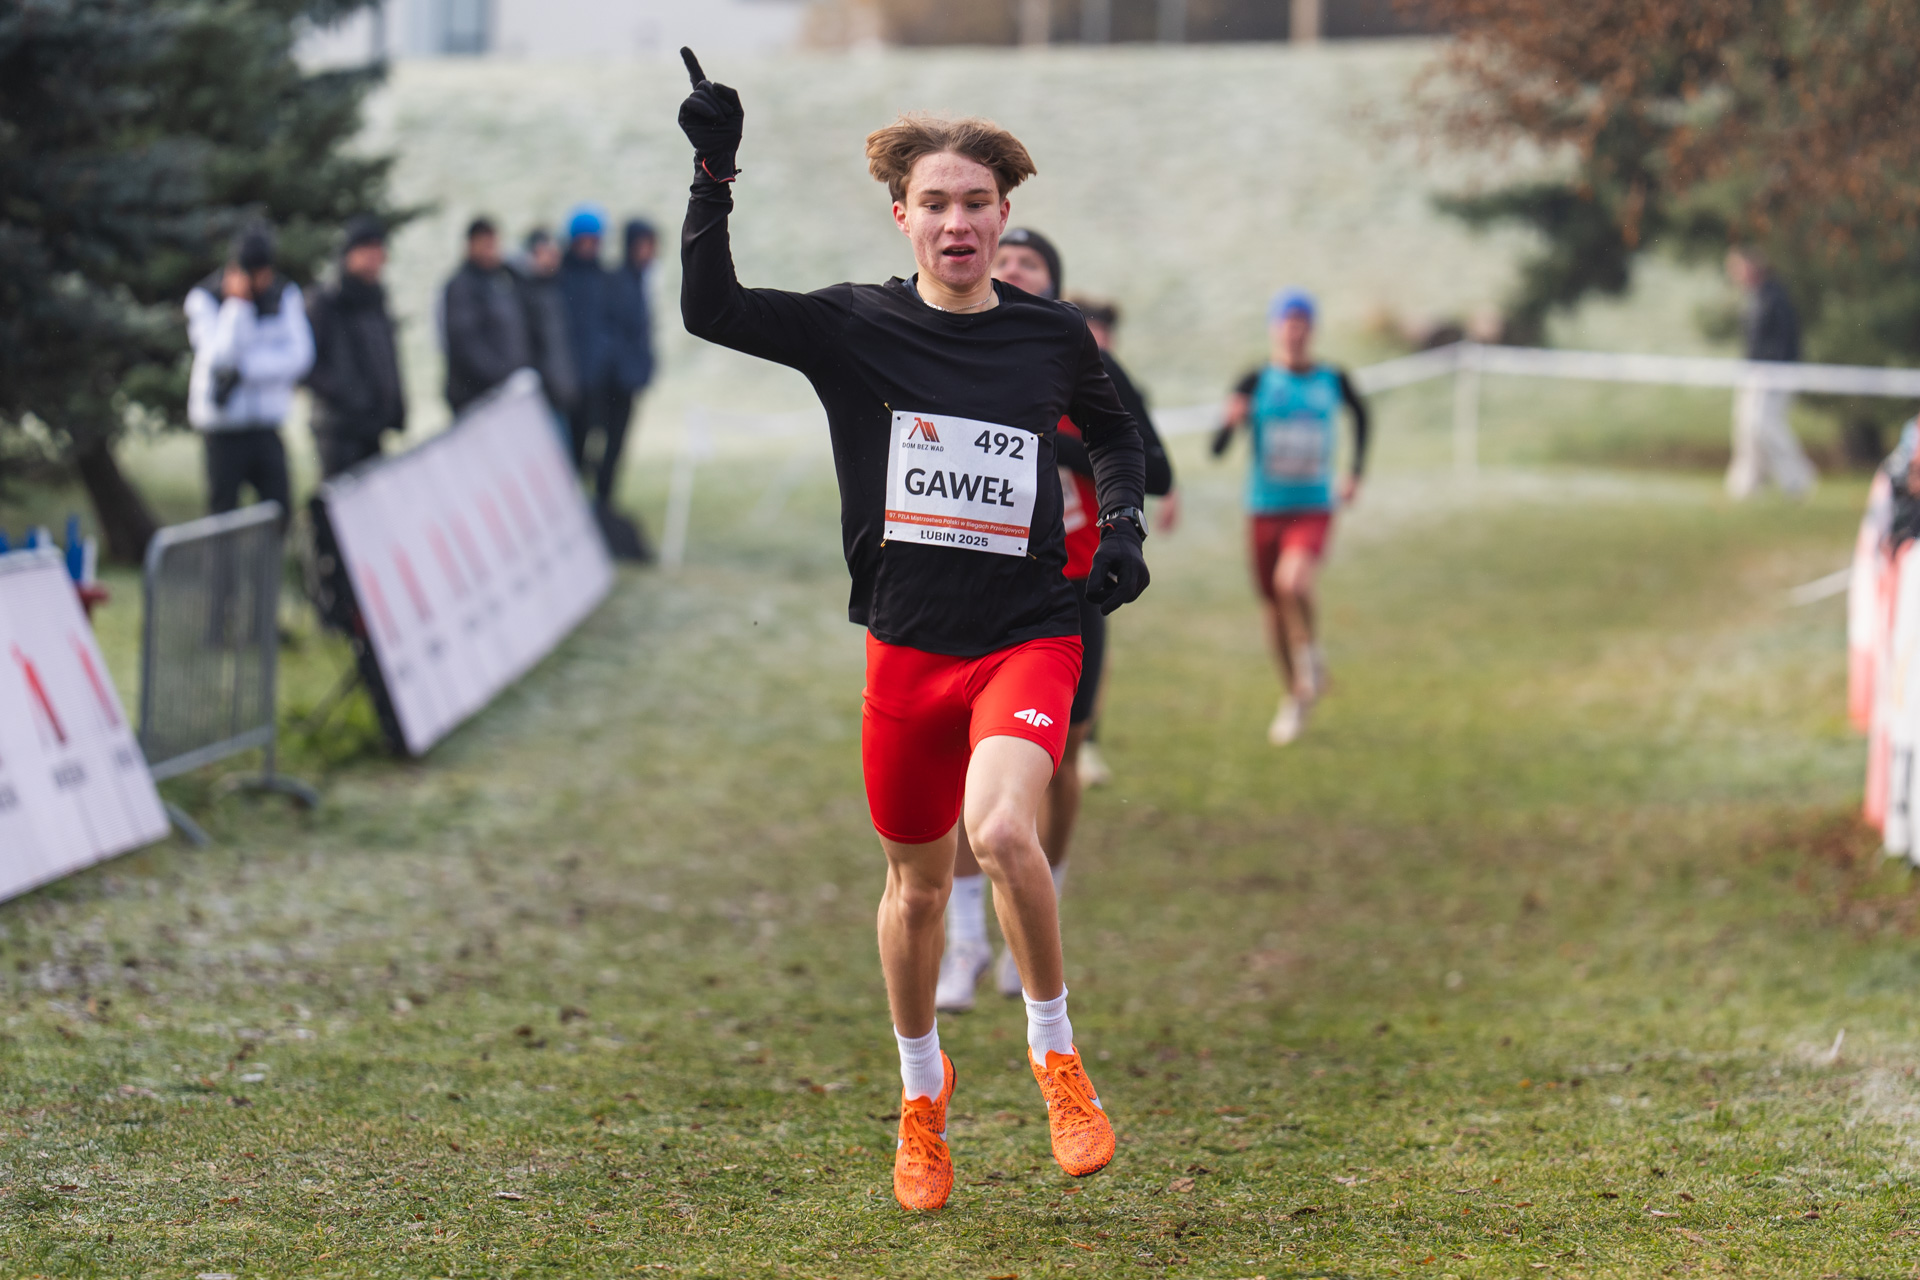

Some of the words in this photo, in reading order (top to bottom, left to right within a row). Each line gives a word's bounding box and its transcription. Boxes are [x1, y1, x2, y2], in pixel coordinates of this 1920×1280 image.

[917, 443, 929, 451] BEZ
[974, 430, 1025, 460] 492
[905, 468, 1015, 507] GAWEŁ
[911, 515, 942, 523] Mistrzostwa
[966, 521, 990, 530] Biegach
[920, 530, 956, 543] LUBIN
[958, 534, 989, 547] 2025
[1013, 708, 1054, 728] 4F
